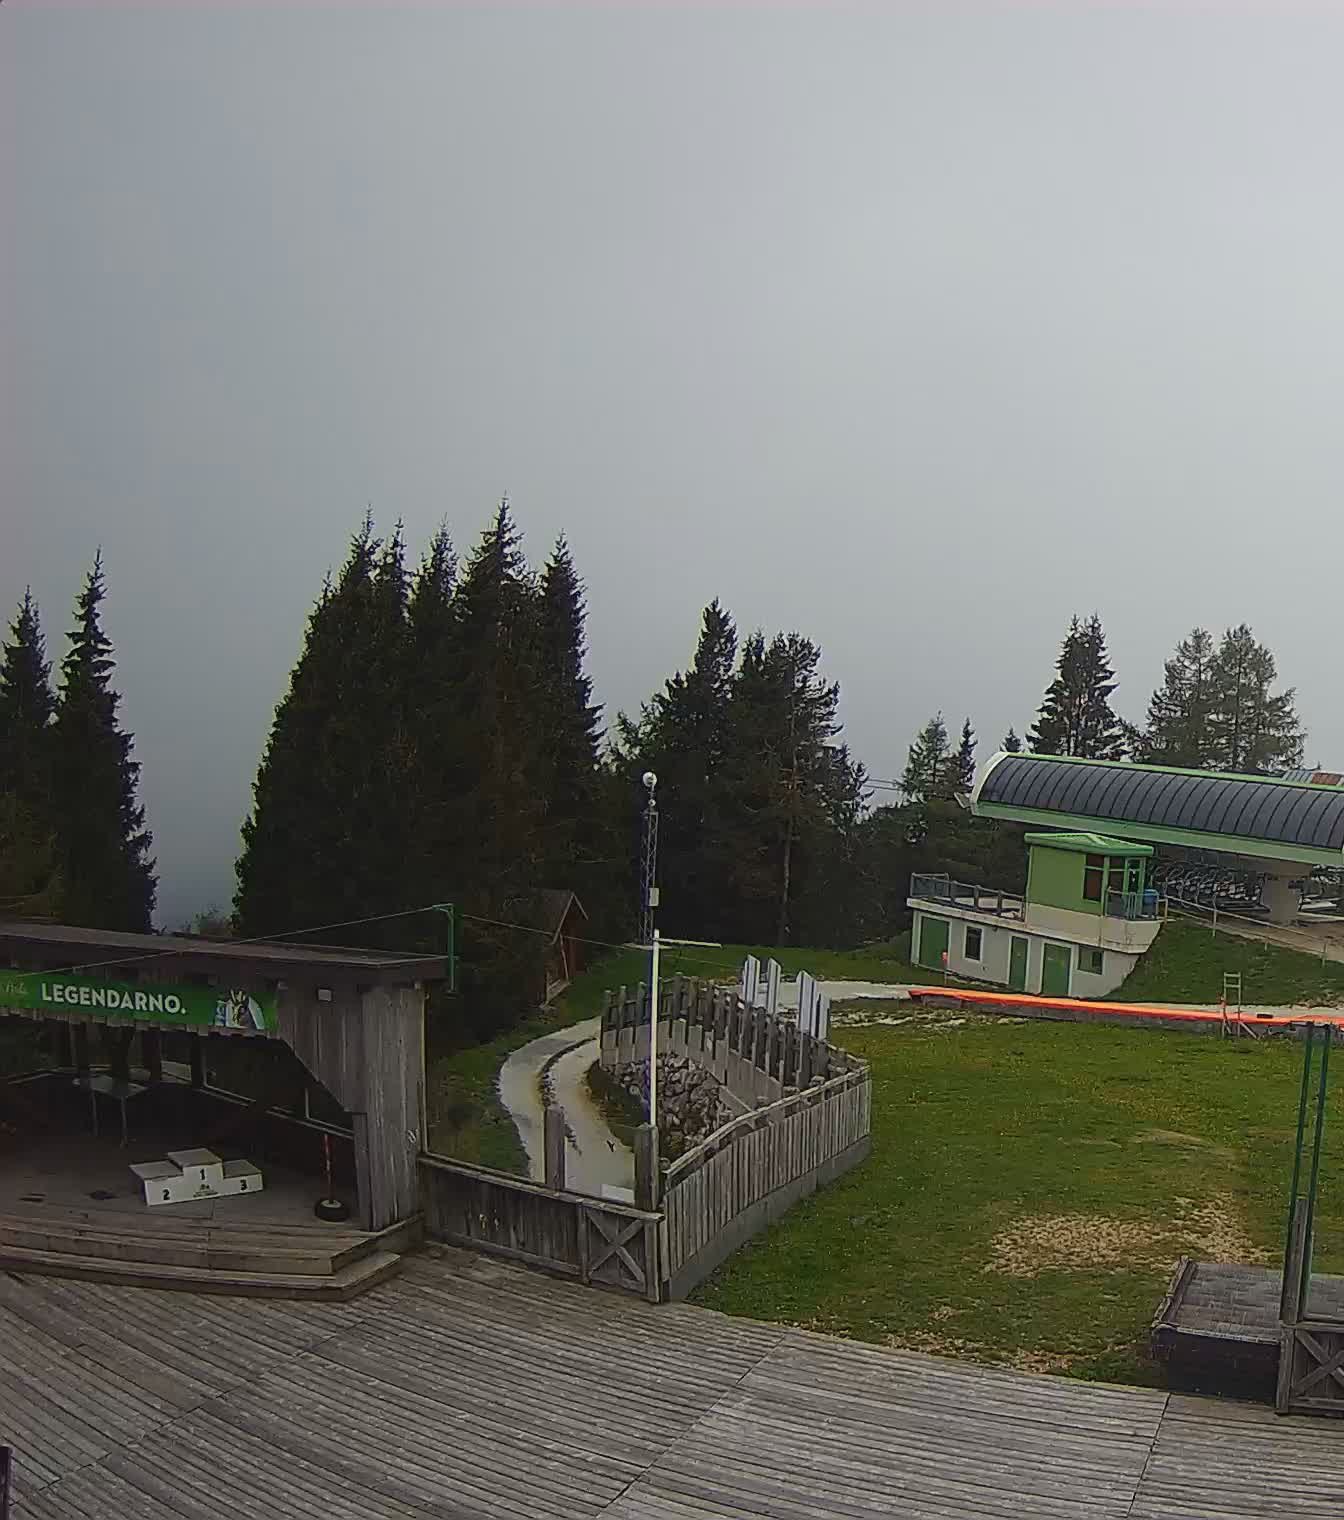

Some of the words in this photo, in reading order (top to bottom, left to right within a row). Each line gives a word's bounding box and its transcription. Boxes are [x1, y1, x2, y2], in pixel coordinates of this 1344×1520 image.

[41, 982, 187, 1015] LEGENDARNO.
[199, 1168, 206, 1181] 1
[239, 1179, 248, 1191] 3
[162, 1188, 170, 1201] 2
